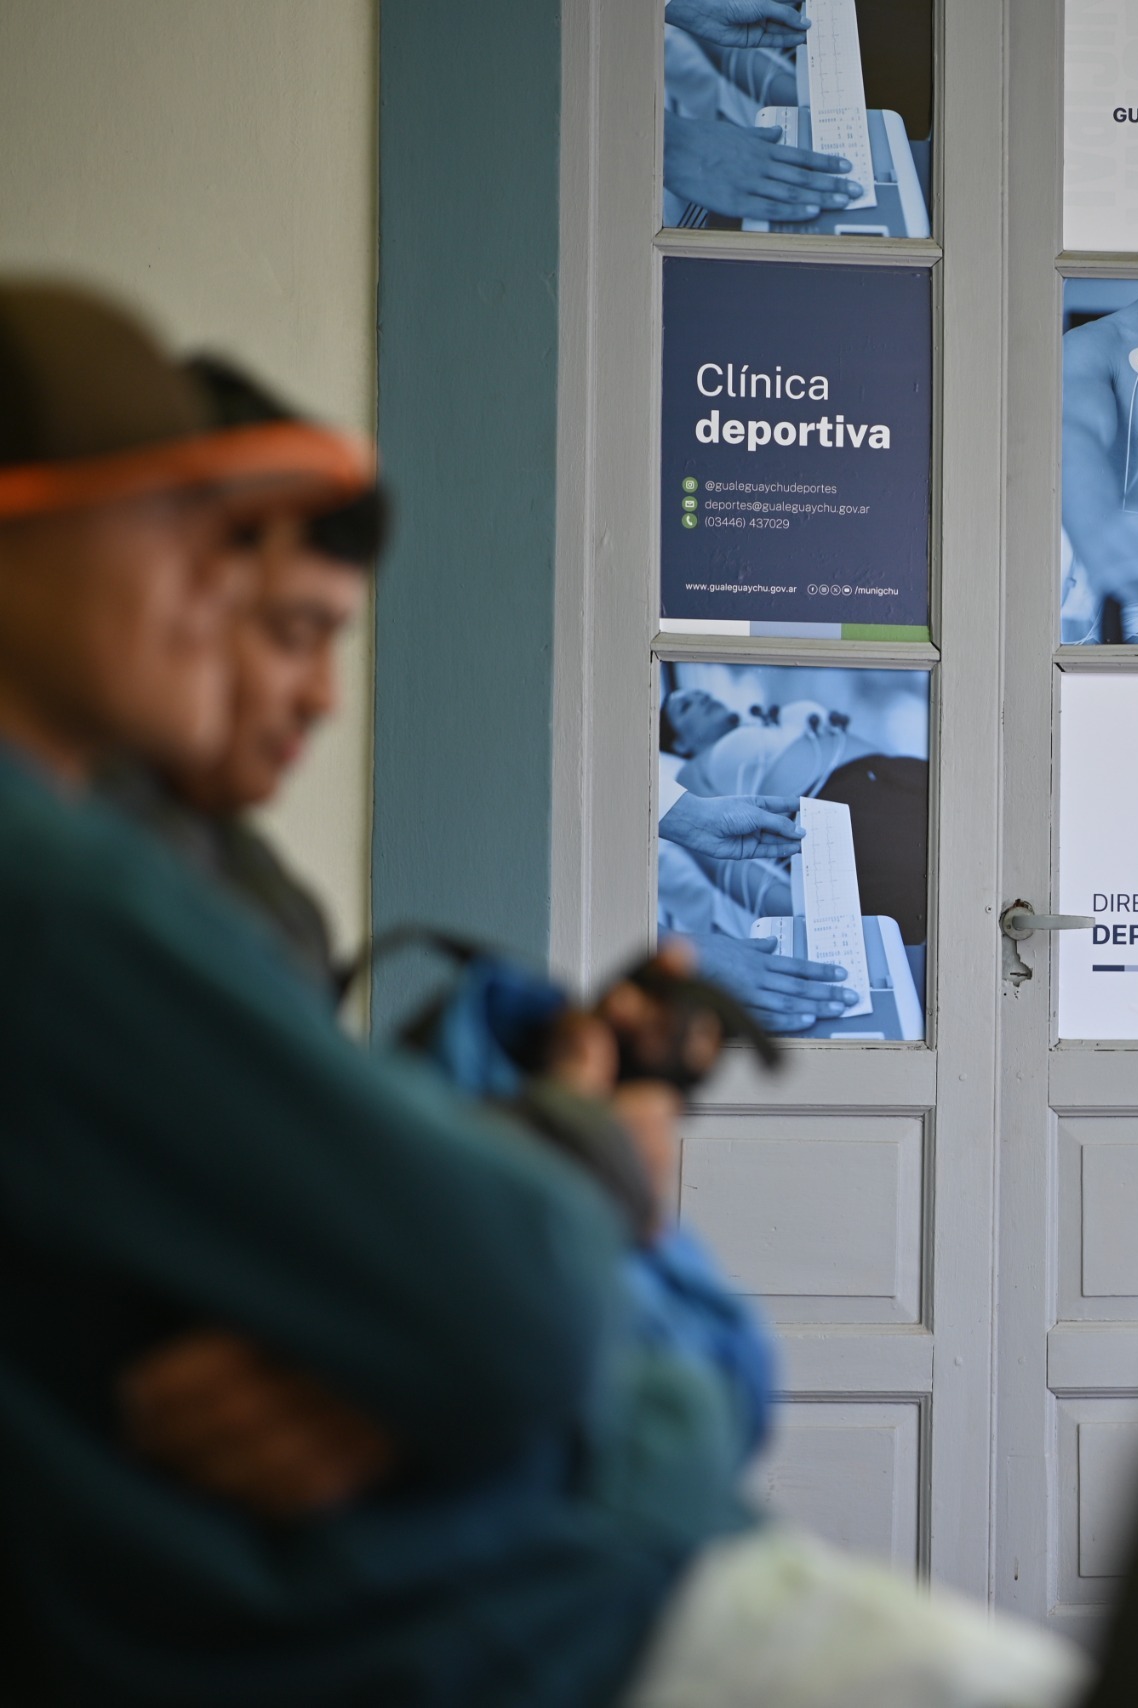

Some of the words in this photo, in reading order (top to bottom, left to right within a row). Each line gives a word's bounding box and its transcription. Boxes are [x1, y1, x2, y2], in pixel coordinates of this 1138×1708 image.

[696, 363, 829, 400] Clínica
[695, 410, 890, 452] deportiva
[705, 480, 837, 494] @gualeguaychudeportes
[705, 499, 870, 515] deportes@gualeguaychu.gov.ar
[705, 517, 746, 528] (03446)
[749, 518, 789, 529] 437029
[685, 582, 797, 594] www.gualeguaychu.gov.ar
[855, 586, 898, 597] /munigchu
